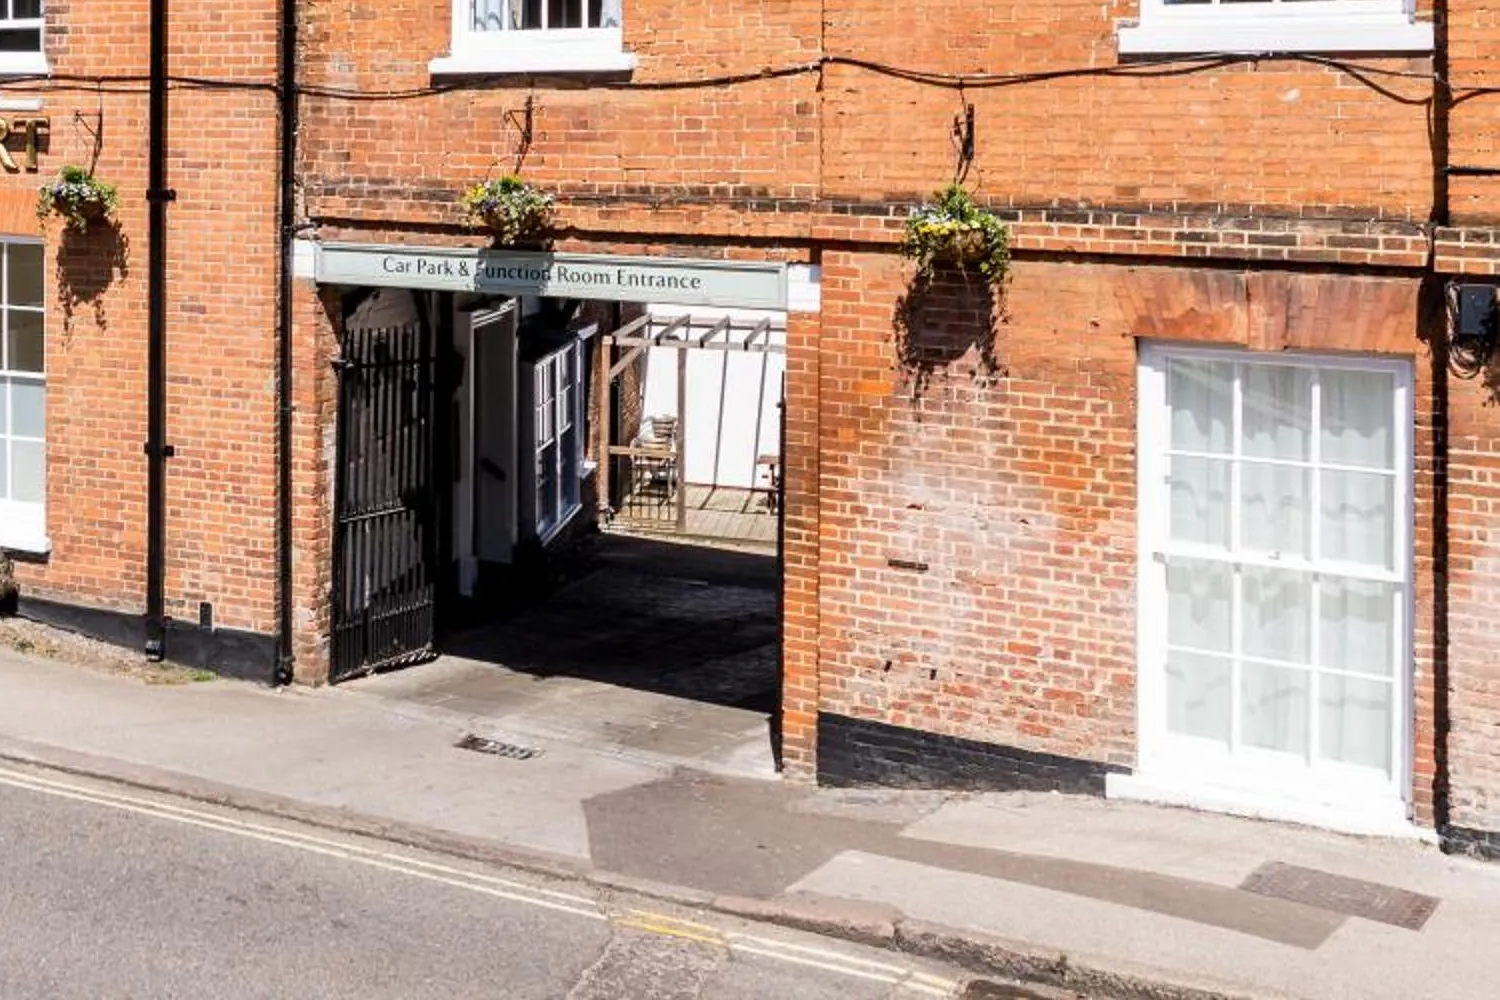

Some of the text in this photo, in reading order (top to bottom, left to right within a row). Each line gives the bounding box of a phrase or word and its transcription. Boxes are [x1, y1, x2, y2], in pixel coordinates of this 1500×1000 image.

[383, 256, 411, 273] Car
[417, 258, 453, 275] Park
[458, 260, 470, 277] &
[557, 265, 611, 285] Room
[616, 268, 701, 289] Entrance
